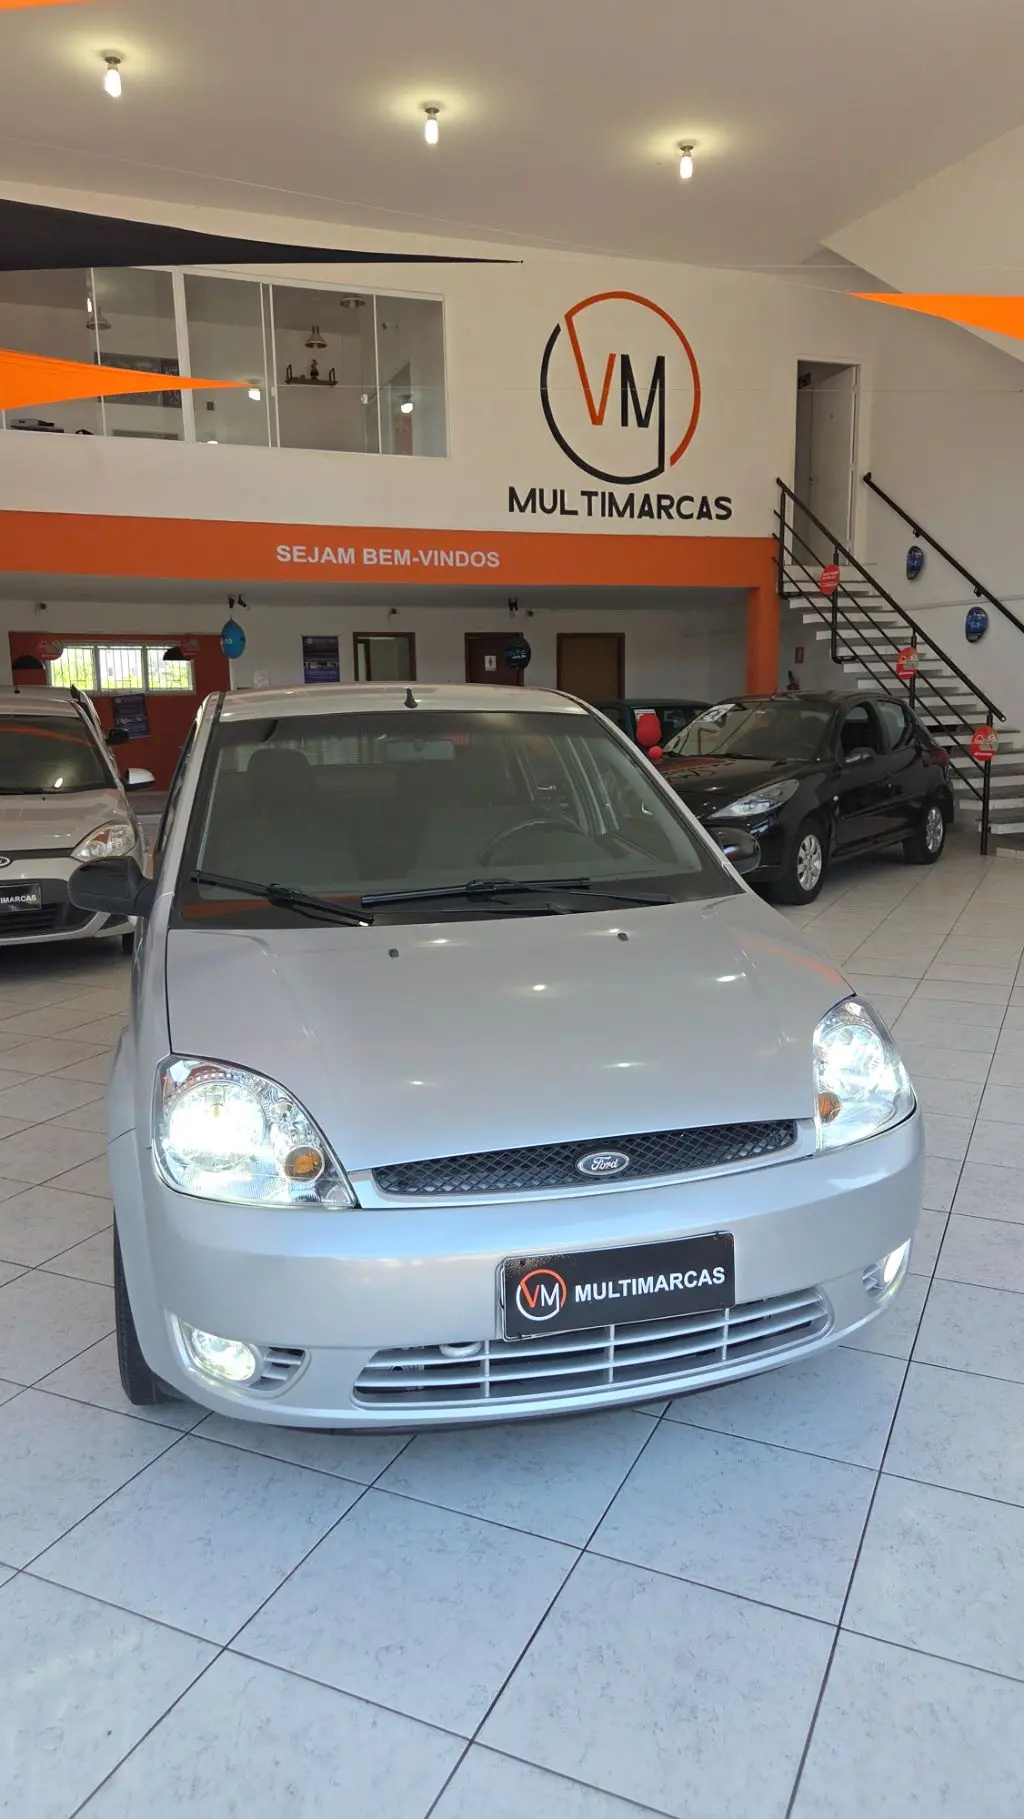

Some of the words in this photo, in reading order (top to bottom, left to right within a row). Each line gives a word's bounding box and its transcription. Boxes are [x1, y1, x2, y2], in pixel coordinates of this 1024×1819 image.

[508, 486, 733, 520] MULTIMARCAS
[276, 545, 355, 564] SEJAM
[363, 548, 500, 568] BEM-VINDOS
[0, 894, 37, 904] IMARCAS
[591, 1155, 619, 1171] Ford
[575, 1266, 726, 1303] MULTIMARCAS
